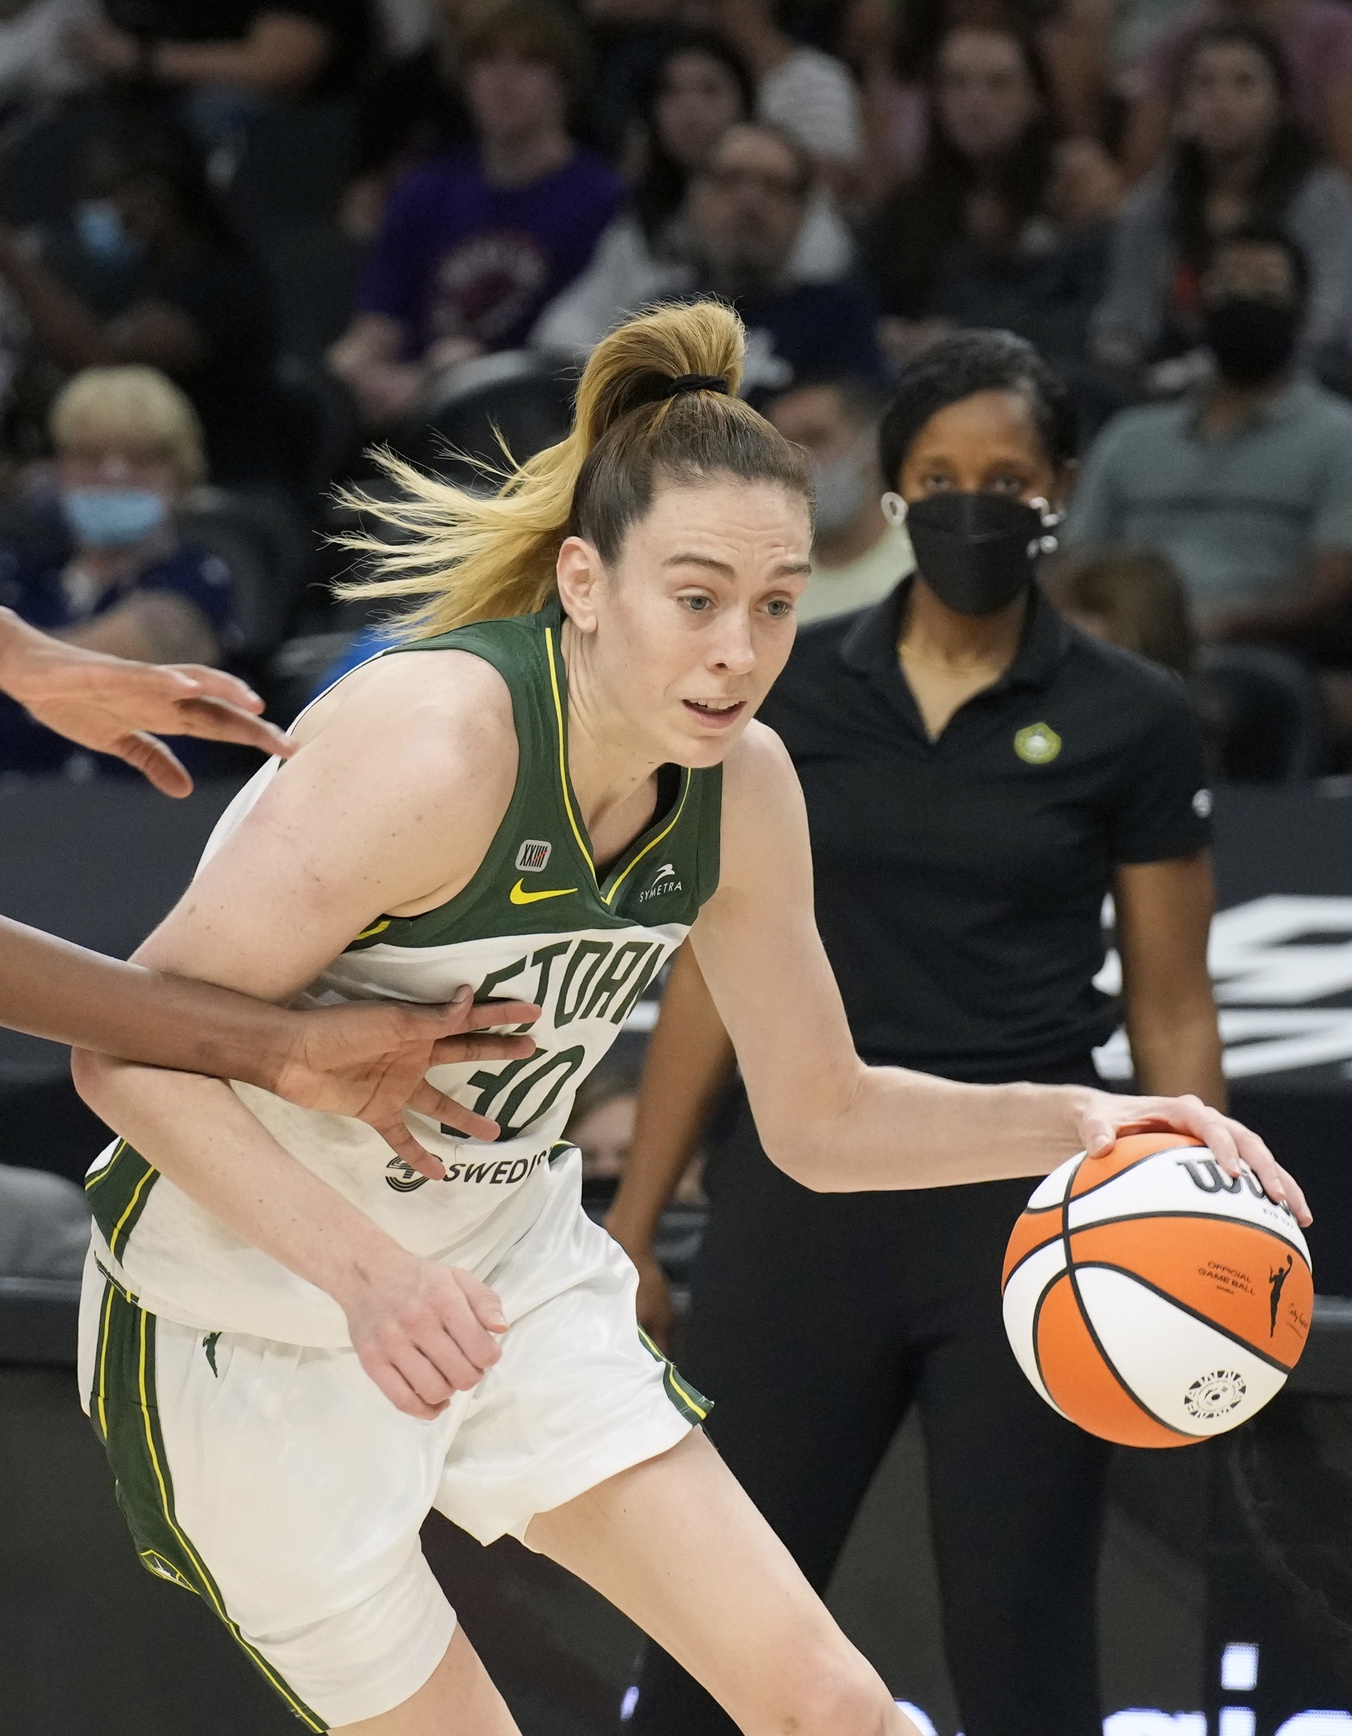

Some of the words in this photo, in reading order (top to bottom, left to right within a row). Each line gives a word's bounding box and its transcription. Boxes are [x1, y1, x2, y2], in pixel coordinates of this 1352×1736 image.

[639, 881, 682, 903] SYMETRA
[1198, 1267, 1230, 1284] GAME
[1231, 1280, 1255, 1295] BALL
[1208, 1261, 1252, 1283] OFFICIAL
